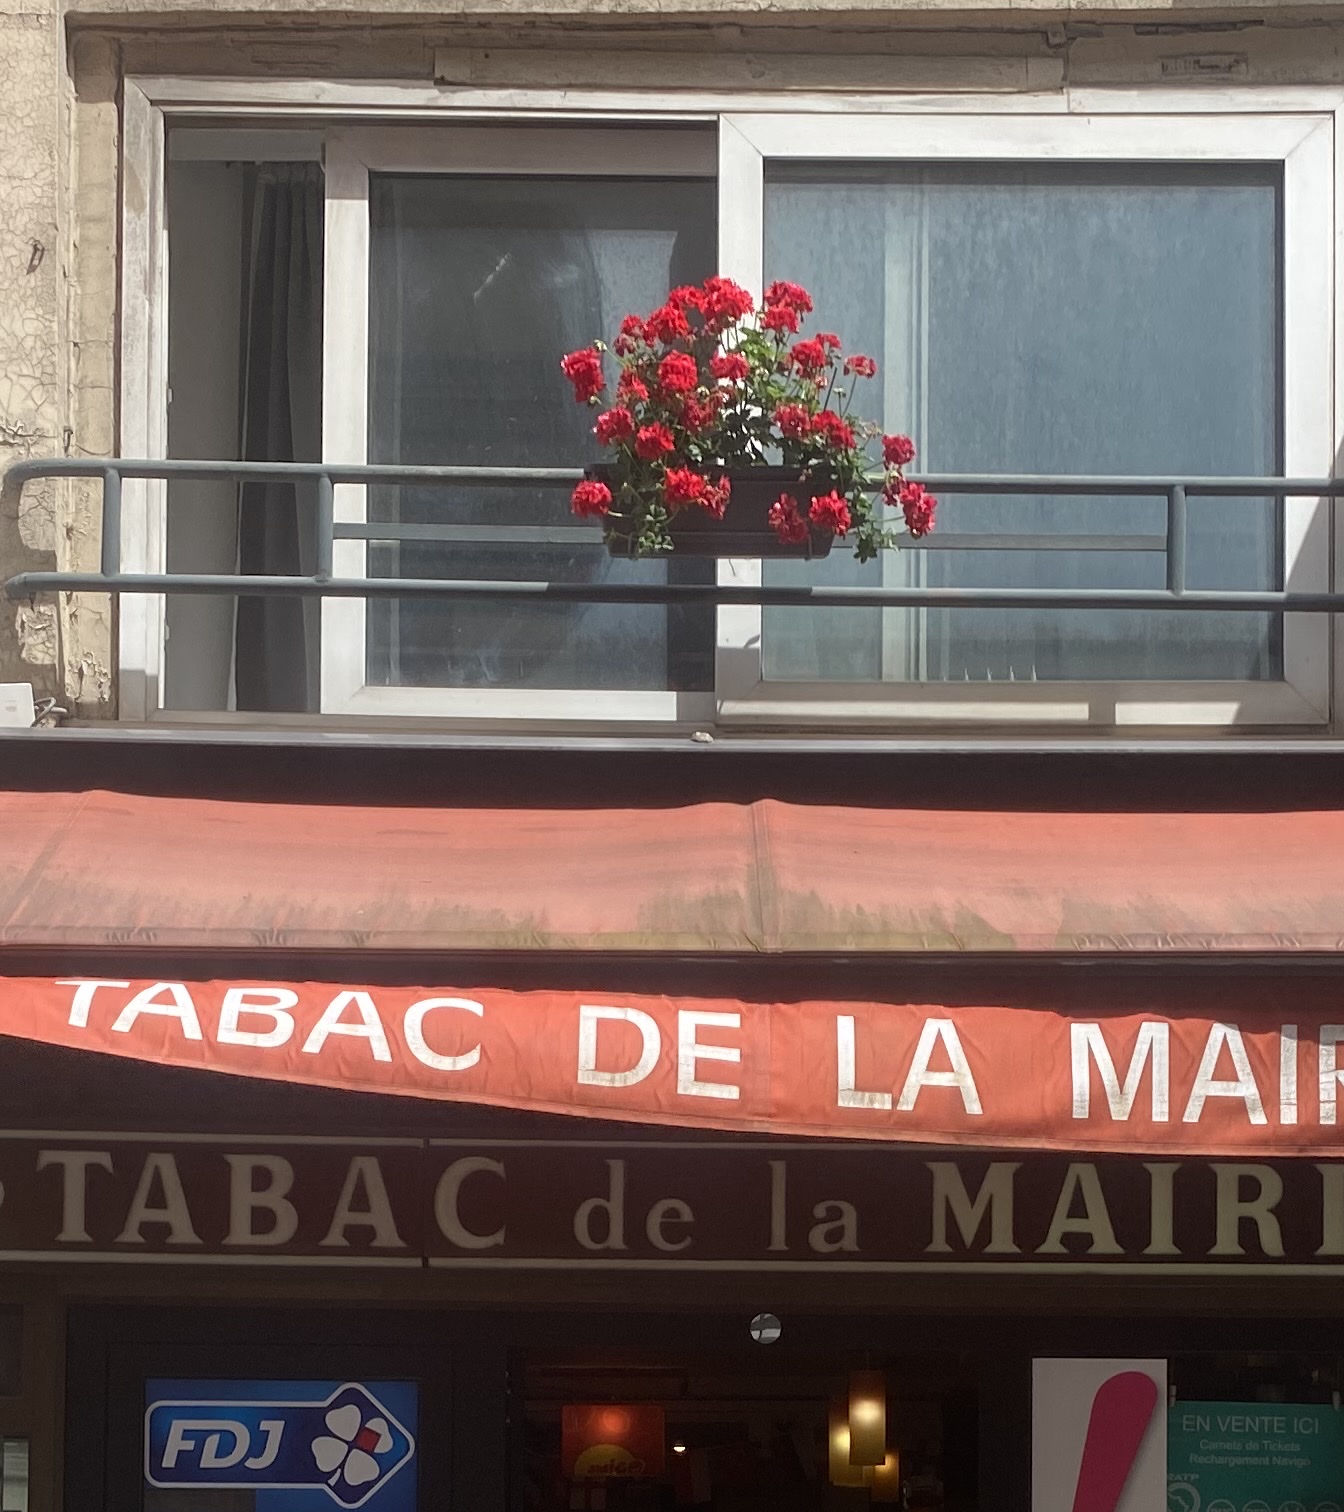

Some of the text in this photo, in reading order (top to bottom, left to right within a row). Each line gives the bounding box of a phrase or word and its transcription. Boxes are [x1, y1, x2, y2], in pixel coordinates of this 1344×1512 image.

[54, 980, 485, 1071] TABAC
[577, 1005, 742, 1100] DE
[836, 1015, 984, 1115] LA
[36, 1150, 508, 1250] TABAC
[573, 1159, 695, 1252] de
[766, 1160, 861, 1252] la
[1182, 1415, 1319, 1434] EN VENTE ICI
[161, 1419, 286, 1470] FDJ
[1189, 1453, 1311, 1468] Rechargement Navigo
[1200, 1439, 1300, 1452] Carnets de Tickets
